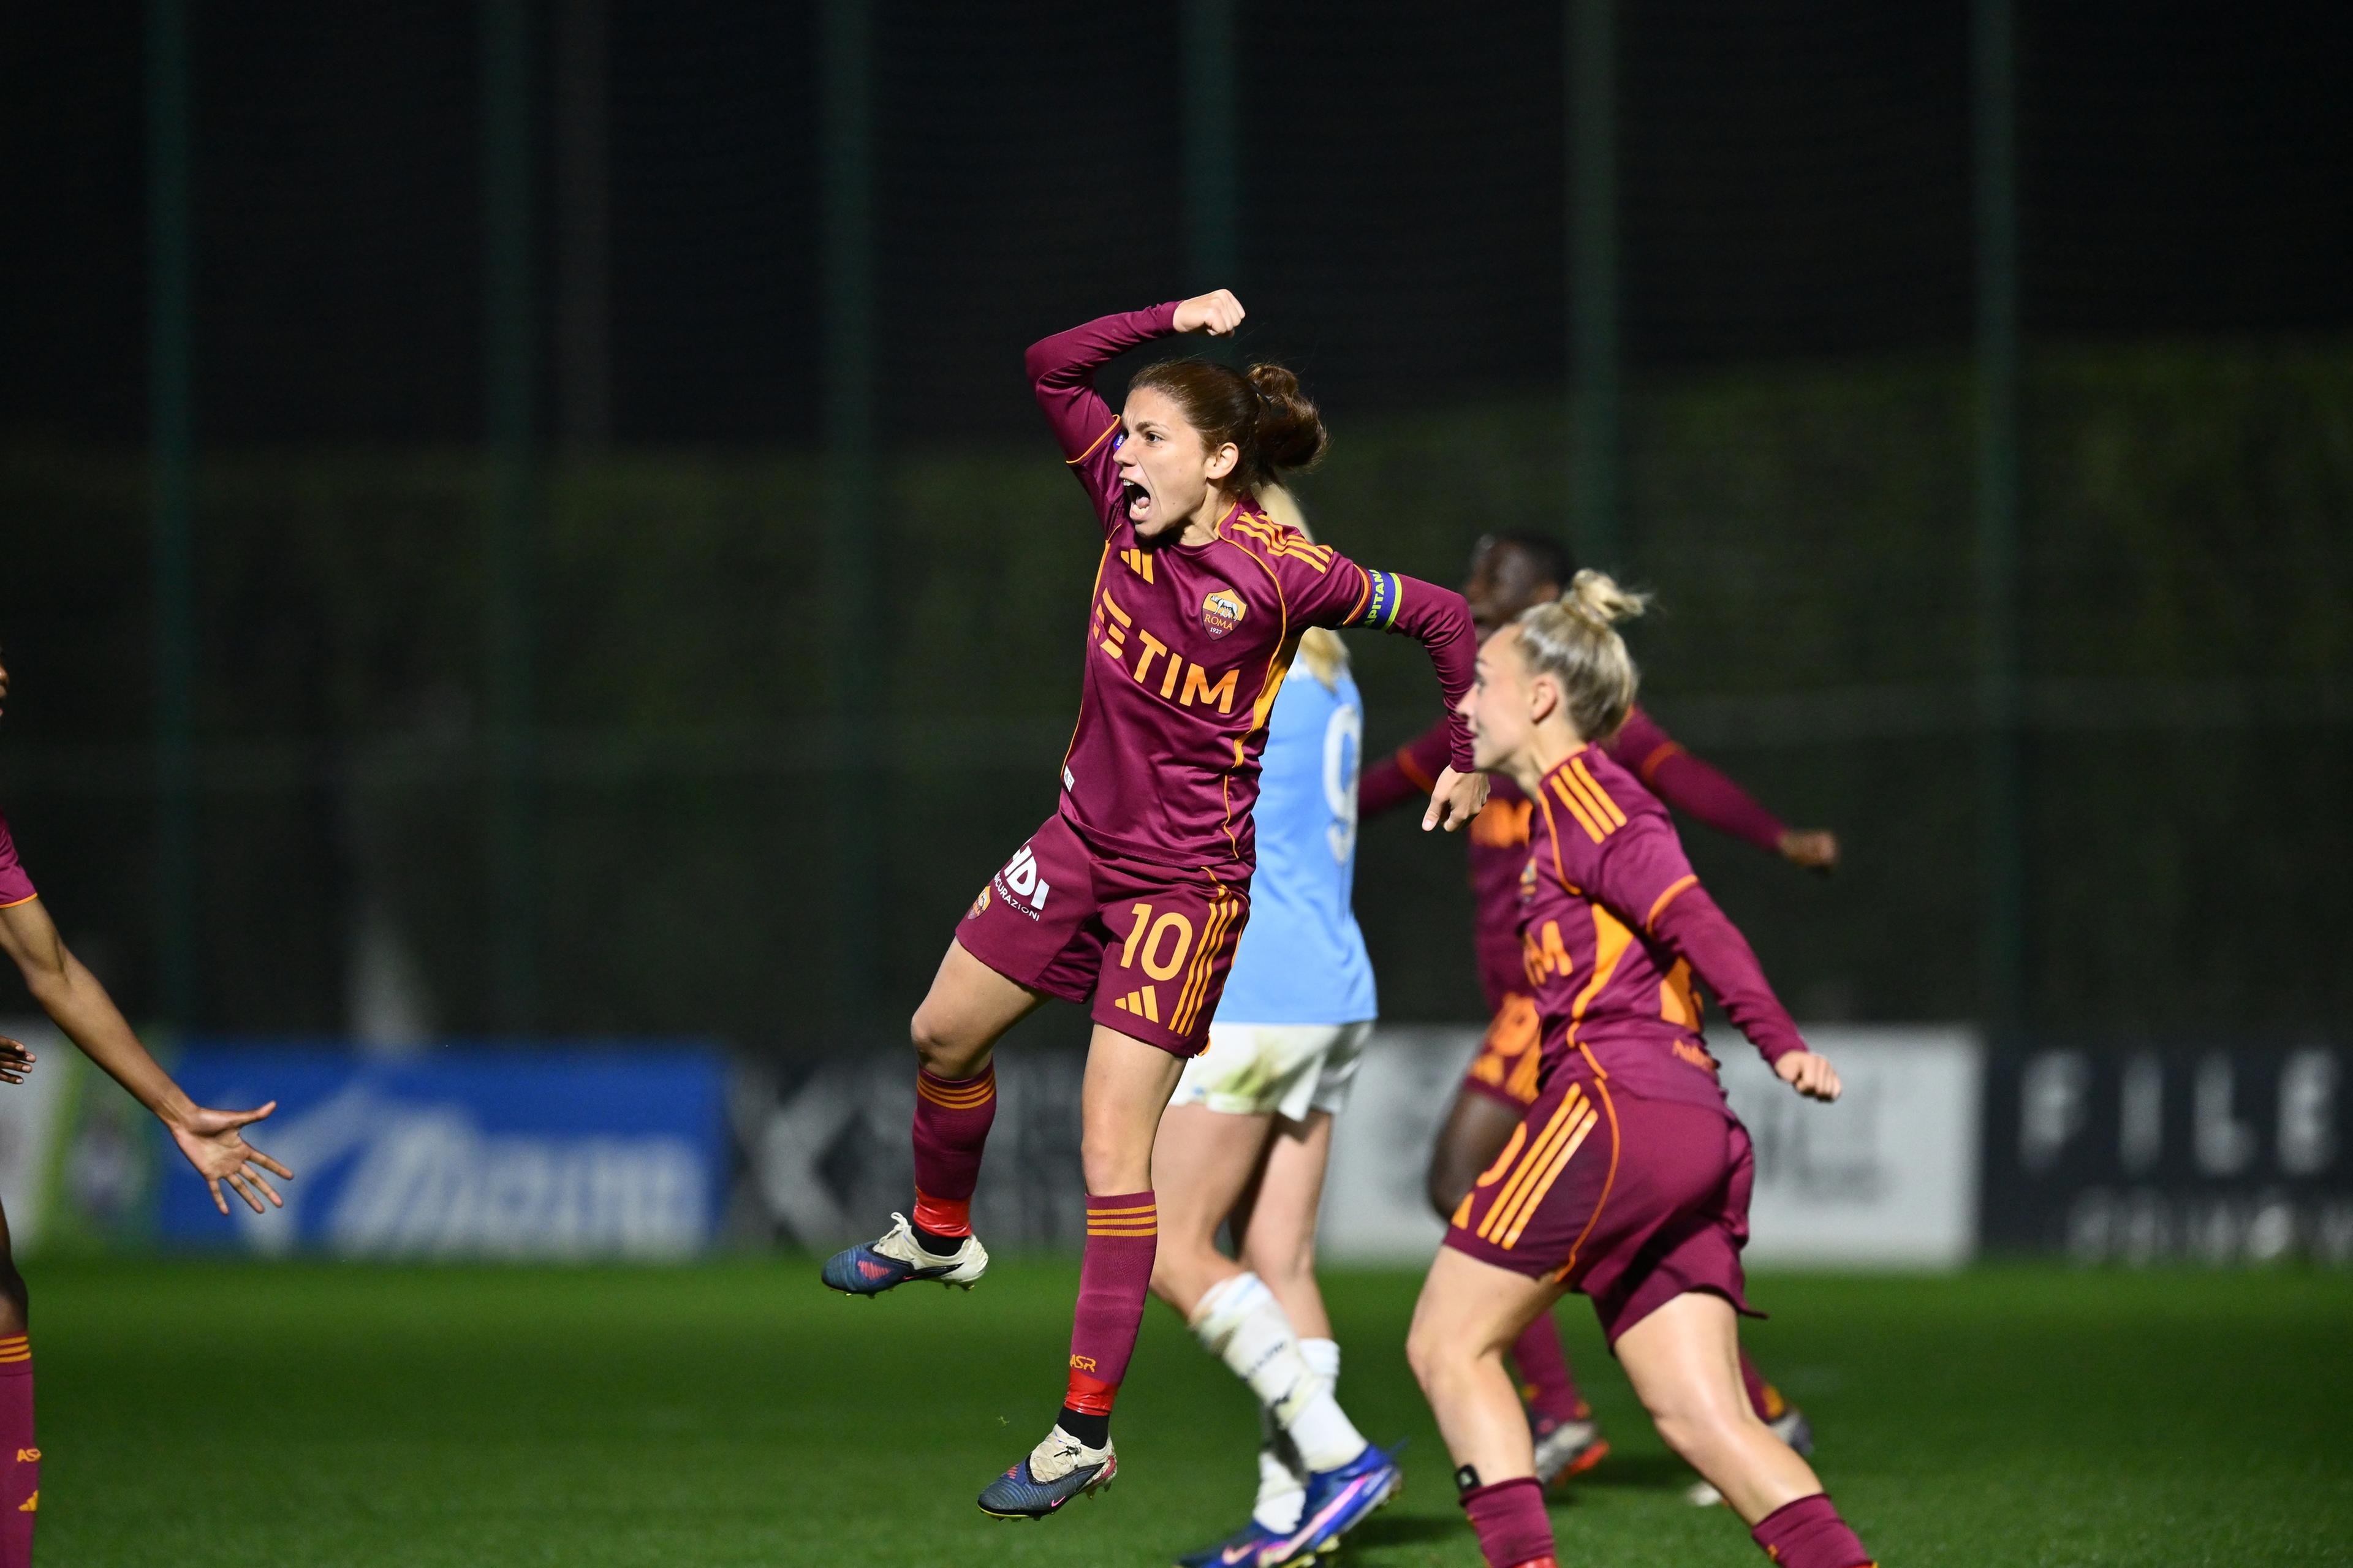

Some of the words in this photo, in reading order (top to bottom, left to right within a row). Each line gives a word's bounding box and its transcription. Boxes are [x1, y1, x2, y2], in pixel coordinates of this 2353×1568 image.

[1204, 613, 1233, 631] ROMA
[1133, 629, 1240, 714] TIM
[1120, 903, 1193, 982] 10
[1069, 1354, 1096, 1373] ASR
[17, 1448, 42, 1463] AS
